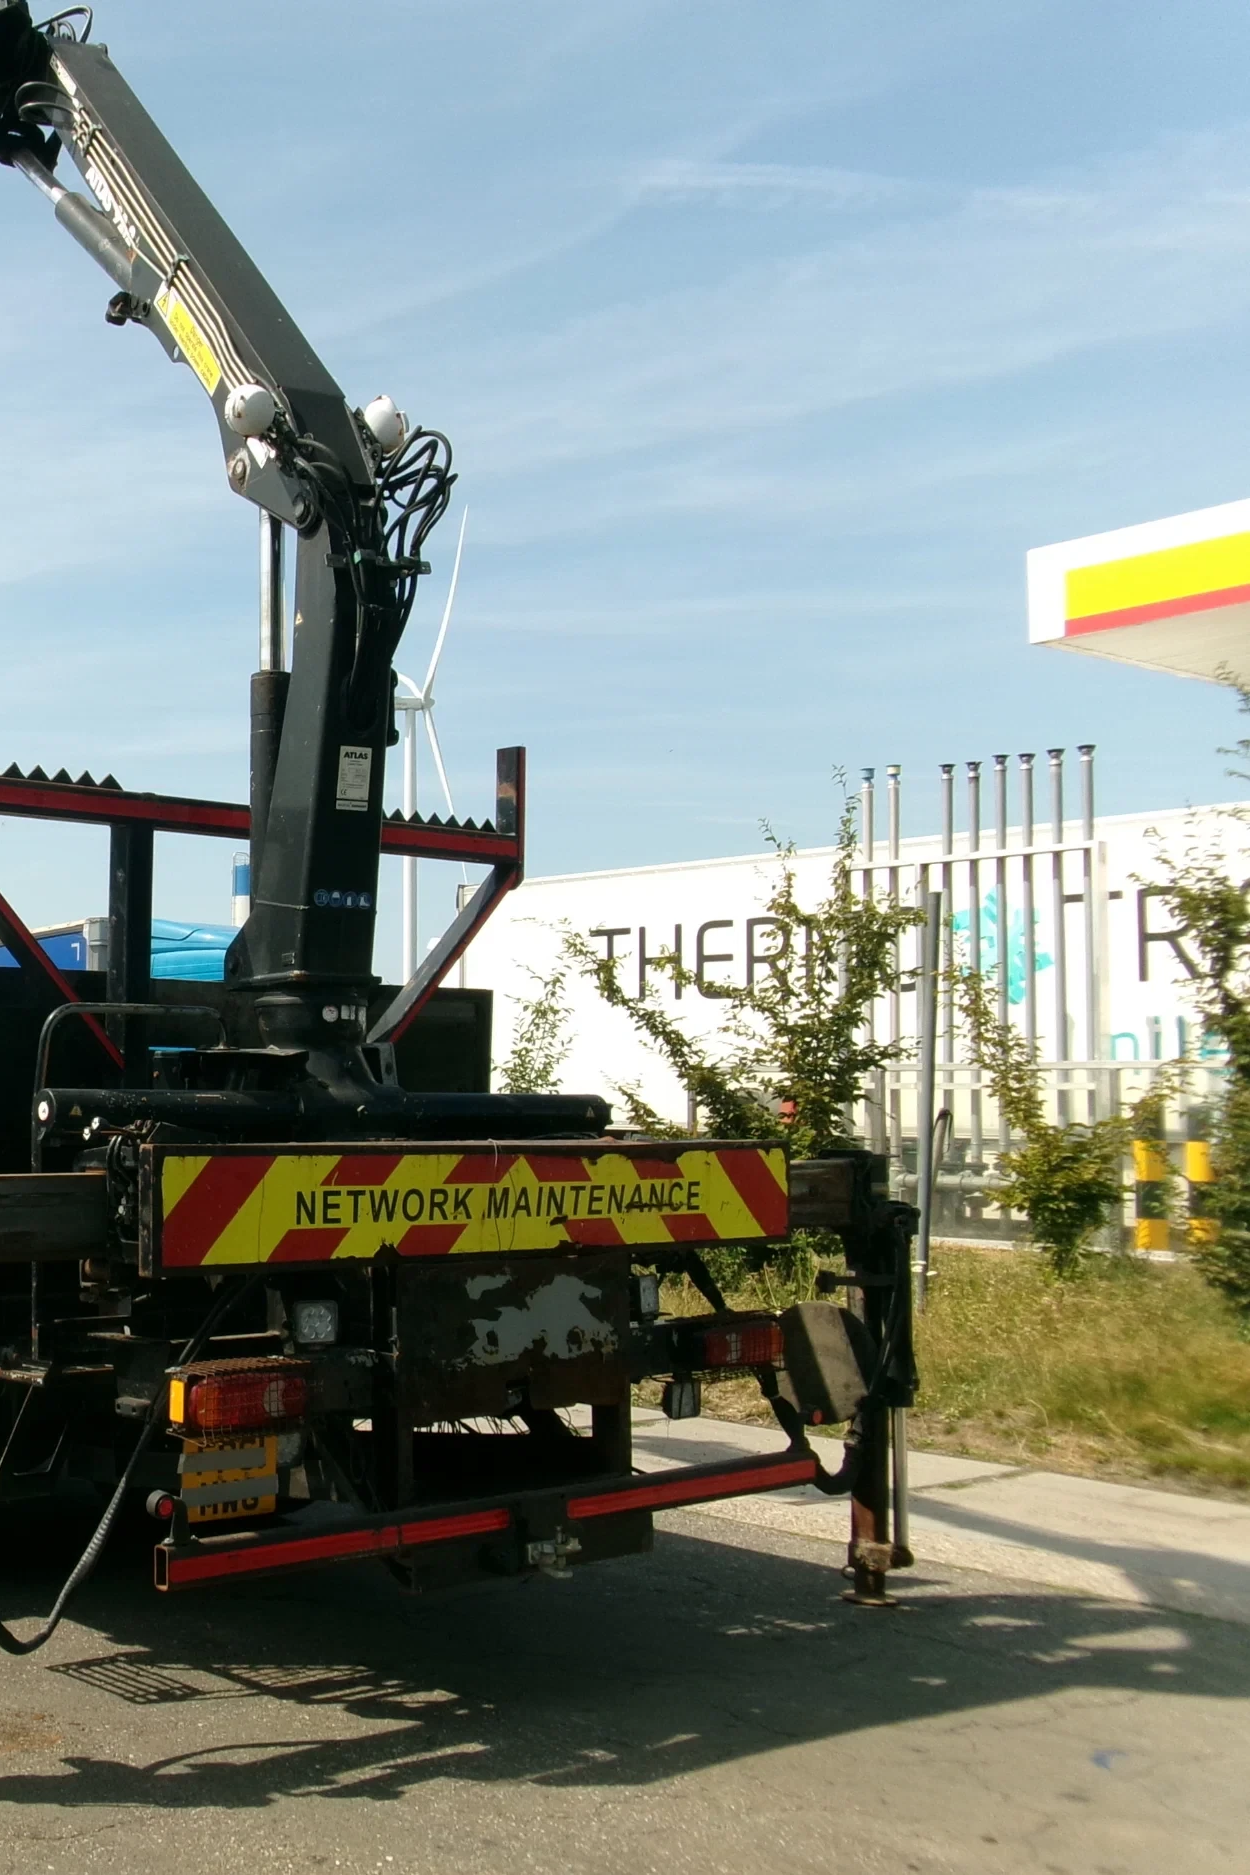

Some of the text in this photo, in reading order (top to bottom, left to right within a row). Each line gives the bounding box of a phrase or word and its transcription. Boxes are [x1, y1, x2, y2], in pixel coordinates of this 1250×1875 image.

[344, 751, 368, 760] ATLAS
[296, 1180, 700, 1225] NETWORK MAINTENANCE
